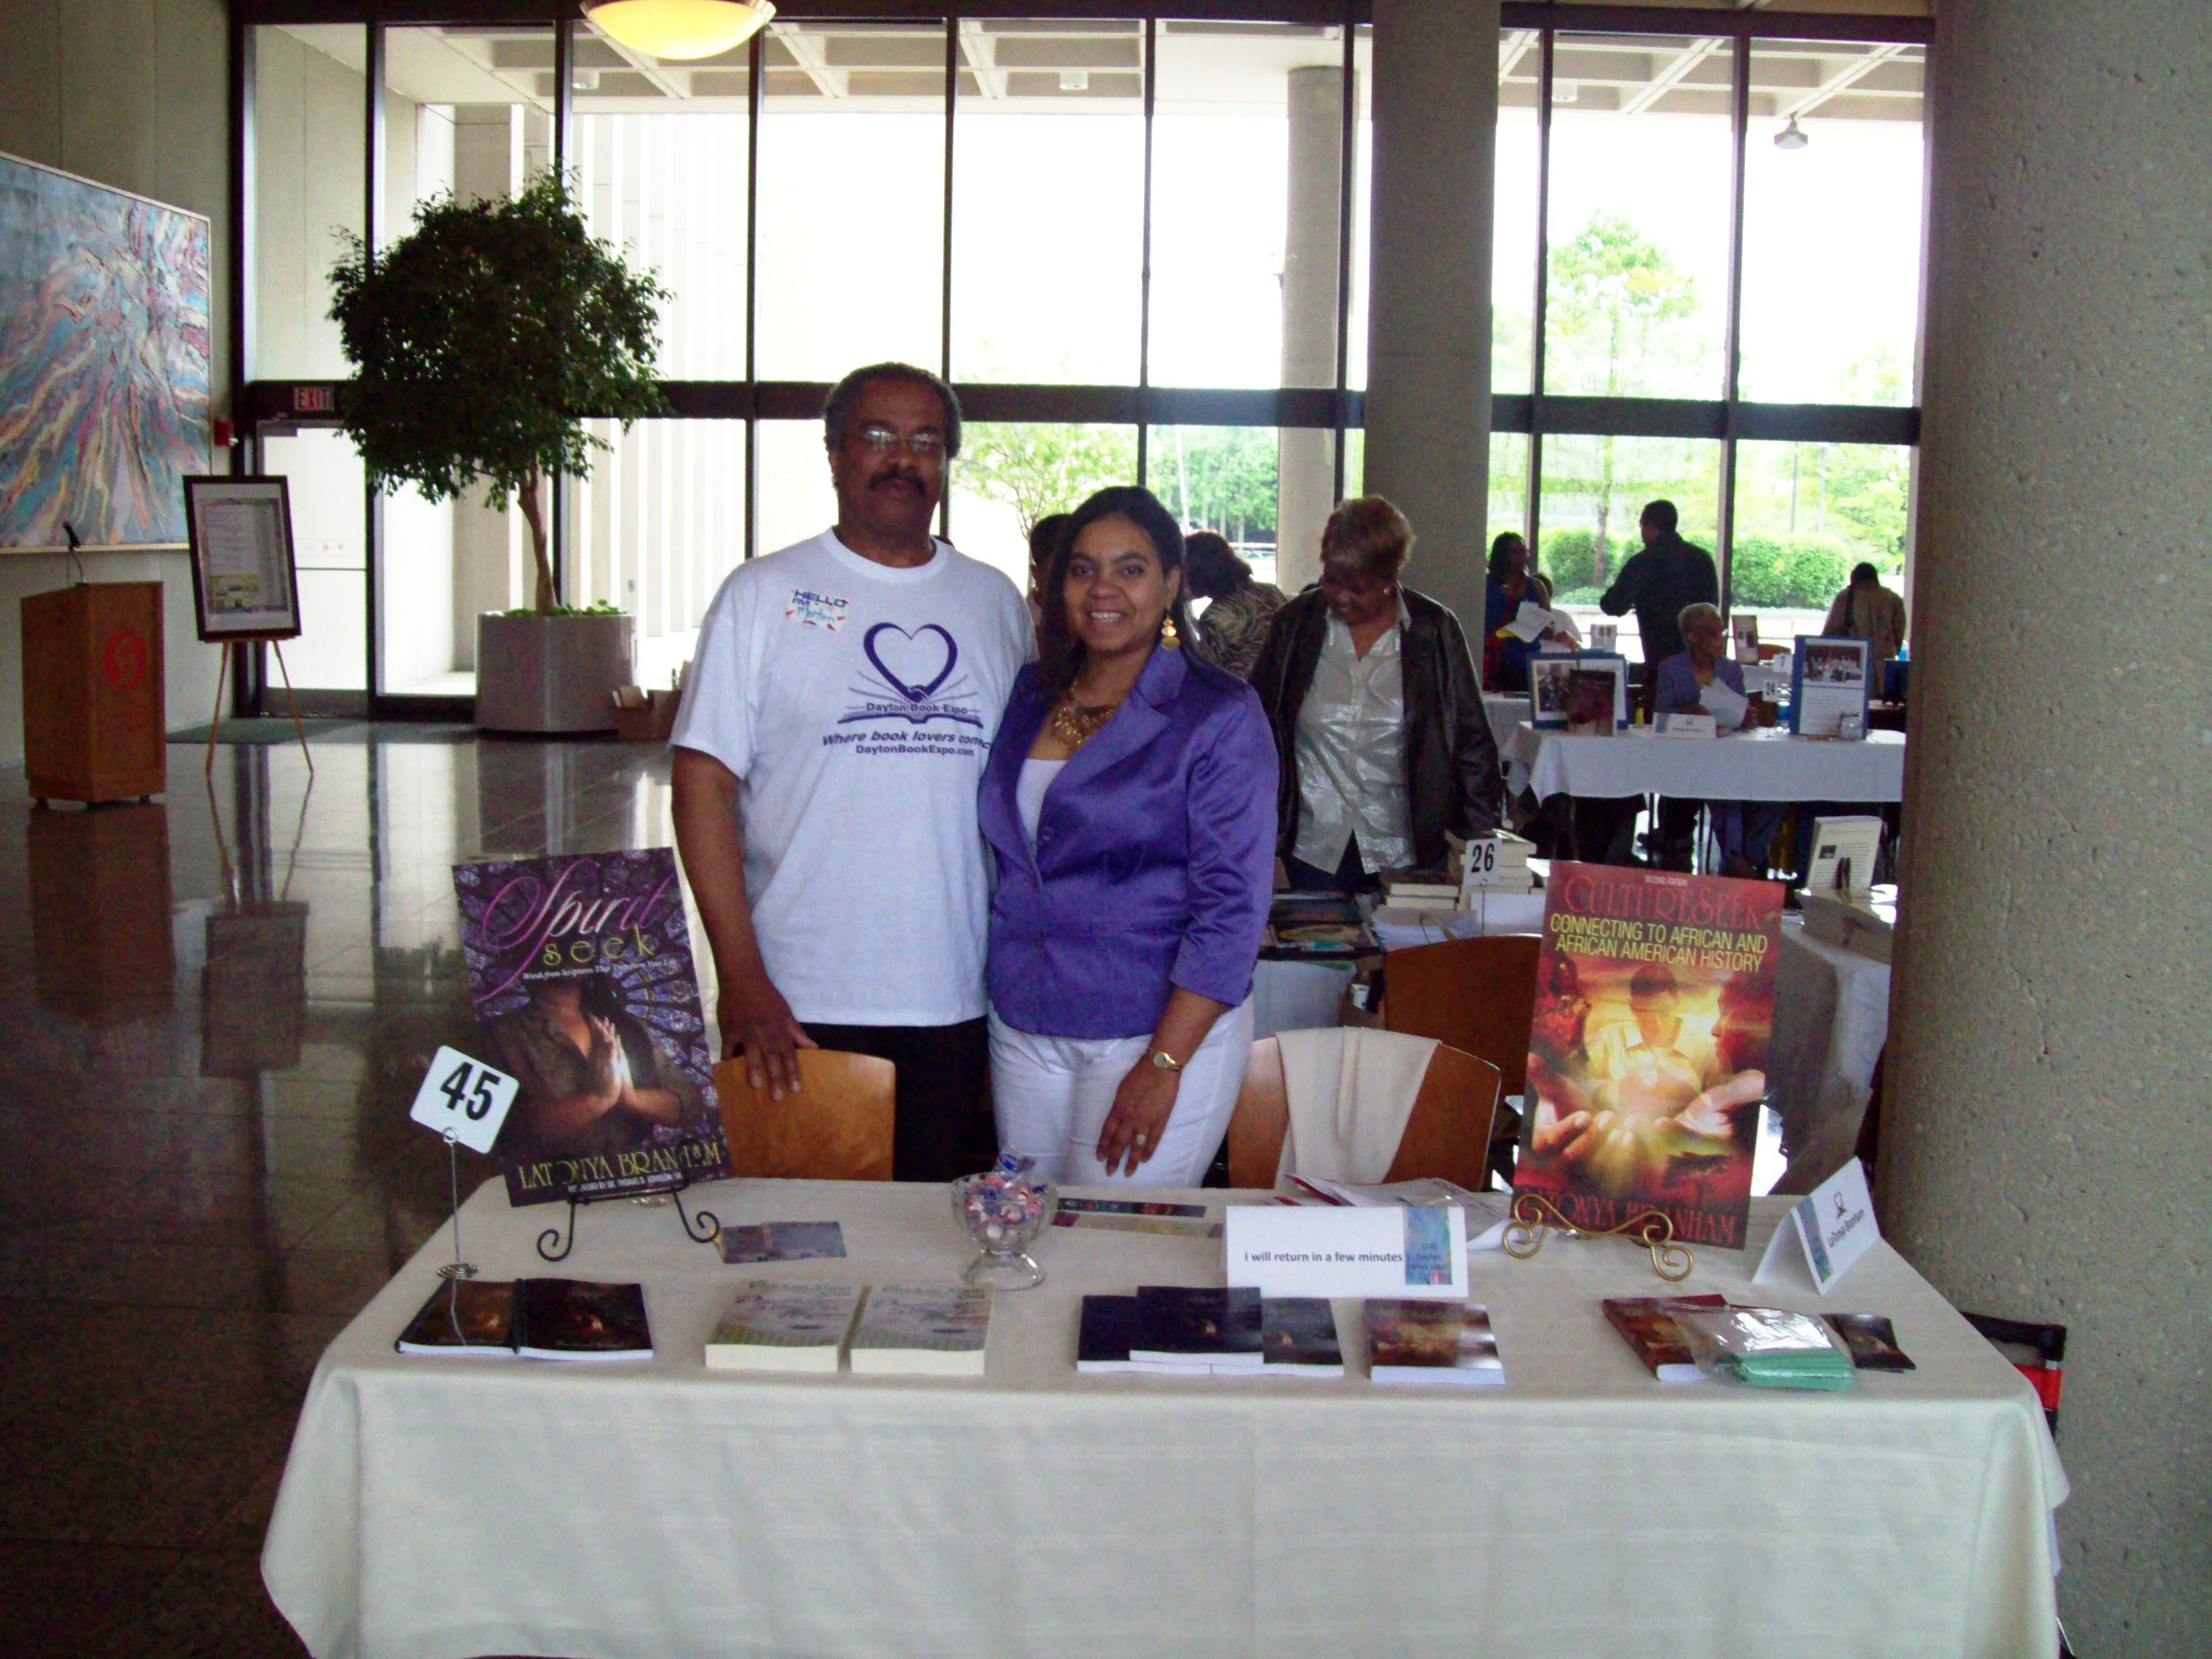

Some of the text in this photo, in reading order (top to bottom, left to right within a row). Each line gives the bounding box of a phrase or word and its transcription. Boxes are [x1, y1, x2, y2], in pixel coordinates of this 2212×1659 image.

[298, 388, 328, 408] EXIT
[794, 589, 846, 607] HELLO
[866, 703, 968, 714] Dayton Book Expo
[823, 732, 866, 746] Where
[870, 730, 909, 742] book
[911, 731, 956, 742] lovers
[856, 744, 975, 756] DaytonBookExpo.com
[1471, 842, 1495, 872] 26
[472, 858, 674, 1005] Spirit
[542, 921, 655, 967] seek
[1550, 913, 1768, 954] CONNECTING TO AFRICAN AND
[1555, 934, 1764, 973] AFRICAN AMERICAN HISTORY
[440, 1060, 501, 1121] 45
[1244, 1251, 1403, 1262] I will return in a few minutes
